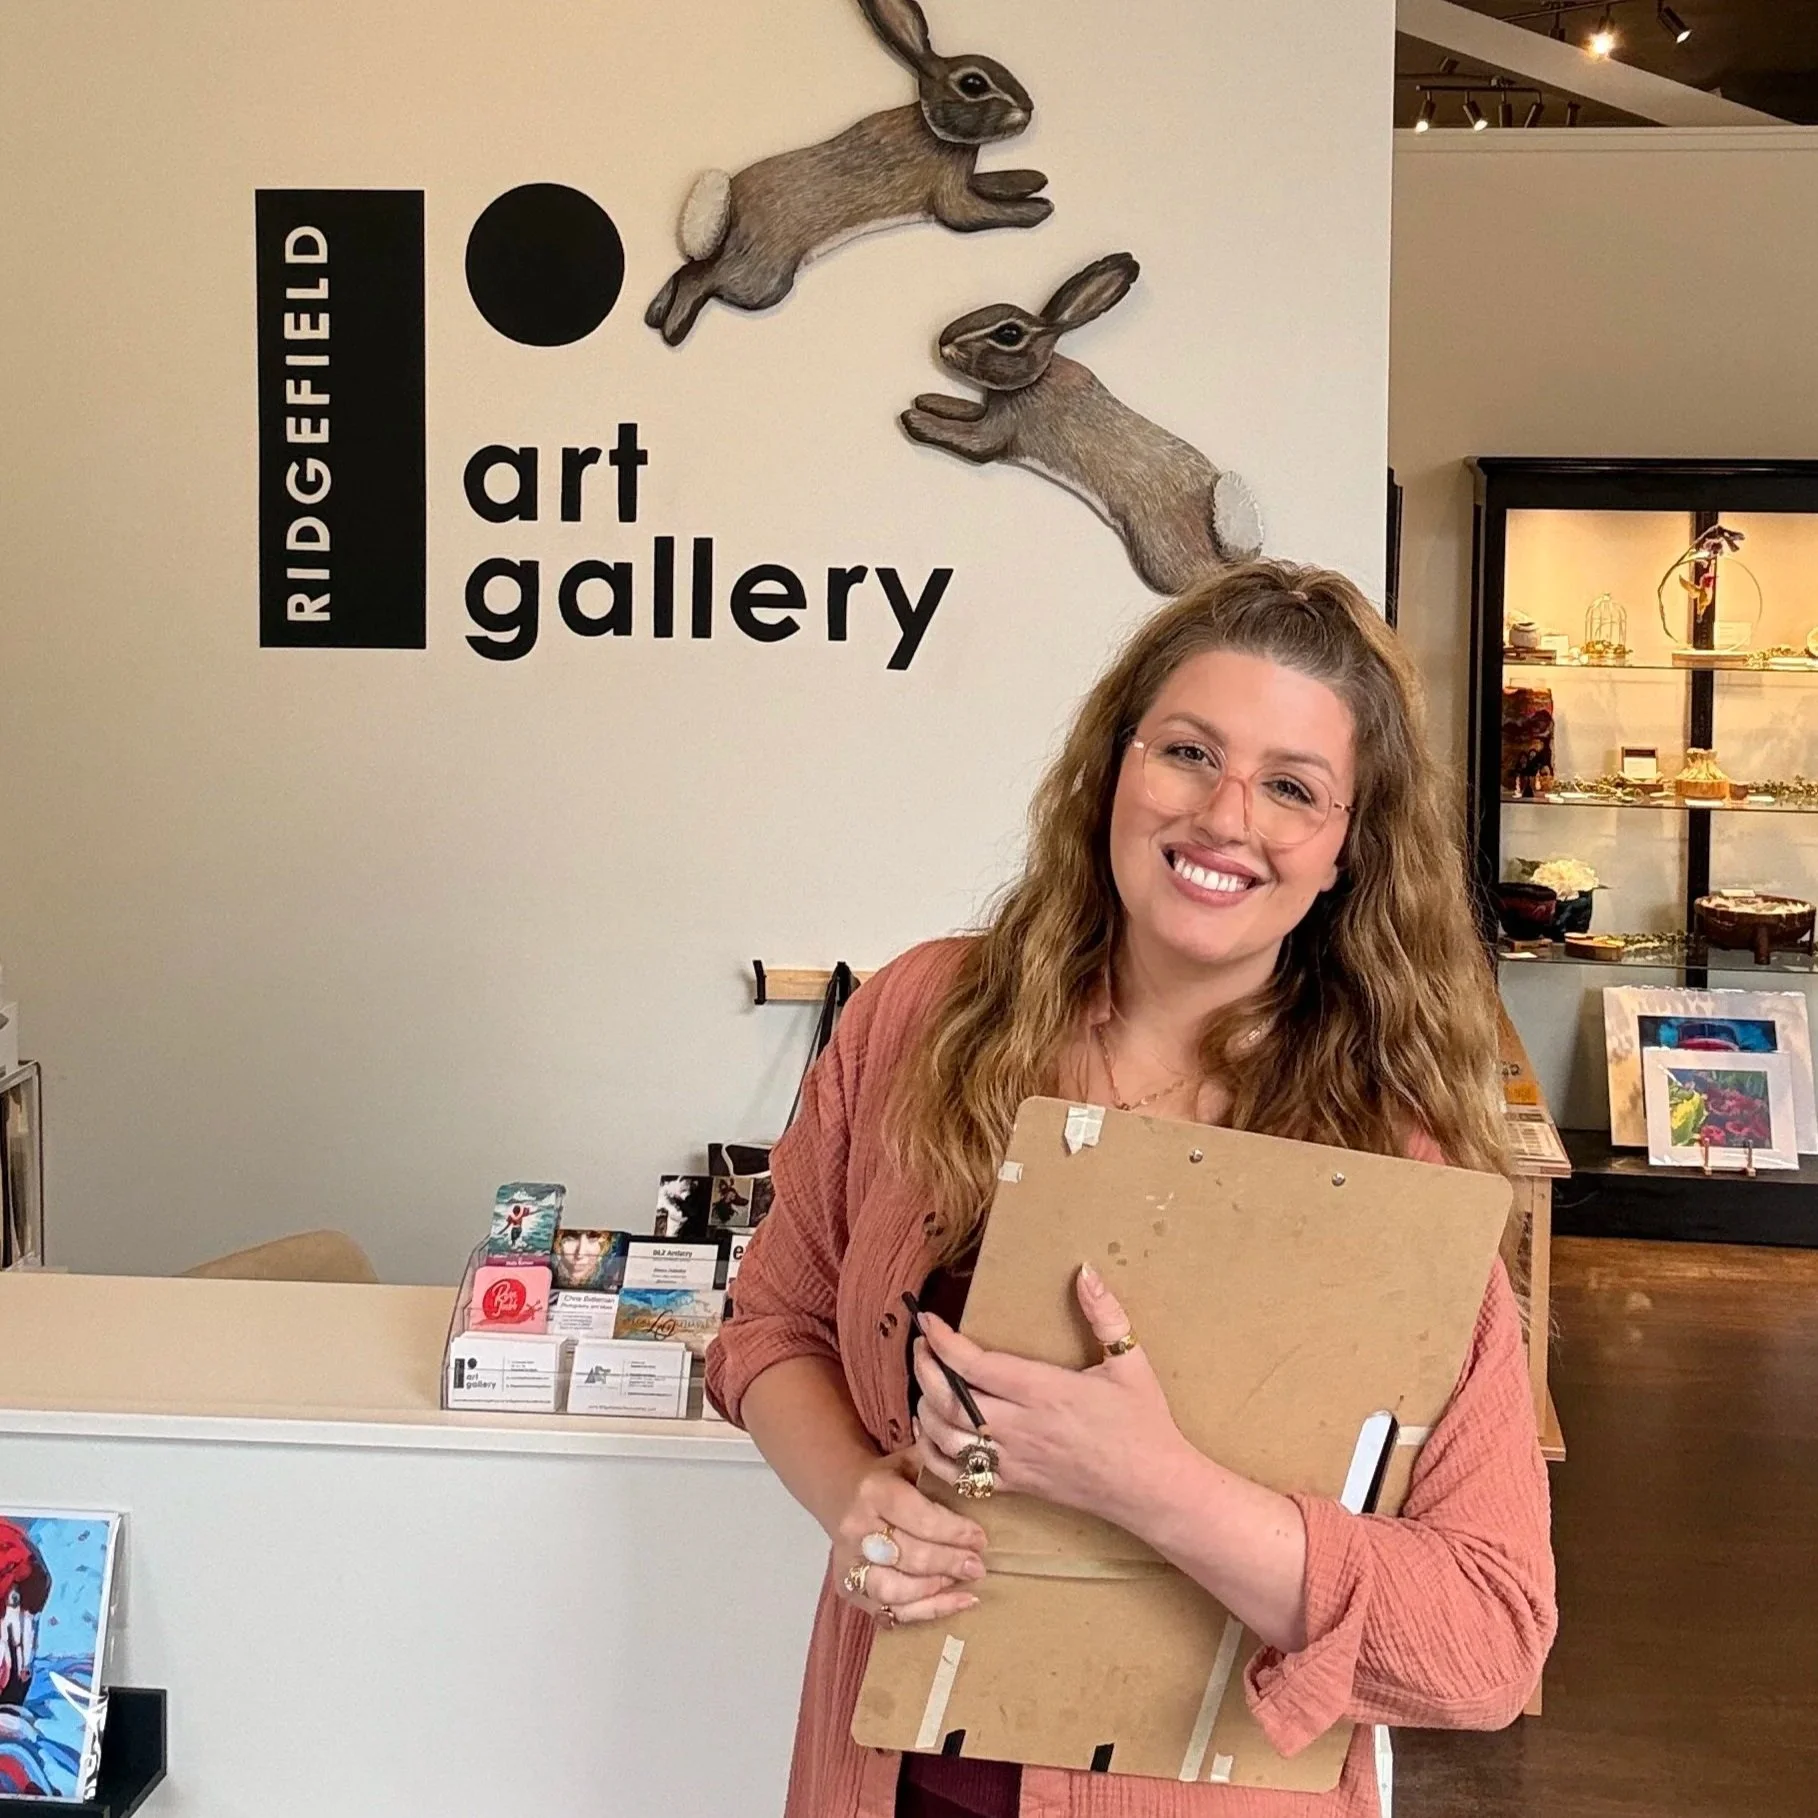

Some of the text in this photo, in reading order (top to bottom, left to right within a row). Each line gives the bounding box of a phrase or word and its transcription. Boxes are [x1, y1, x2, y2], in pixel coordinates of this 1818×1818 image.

[284, 225, 332, 622] RIDGEFIELD
[464, 422, 649, 524] art
[464, 535, 954, 671] gallery
[466, 1381, 496, 1390] gallery
